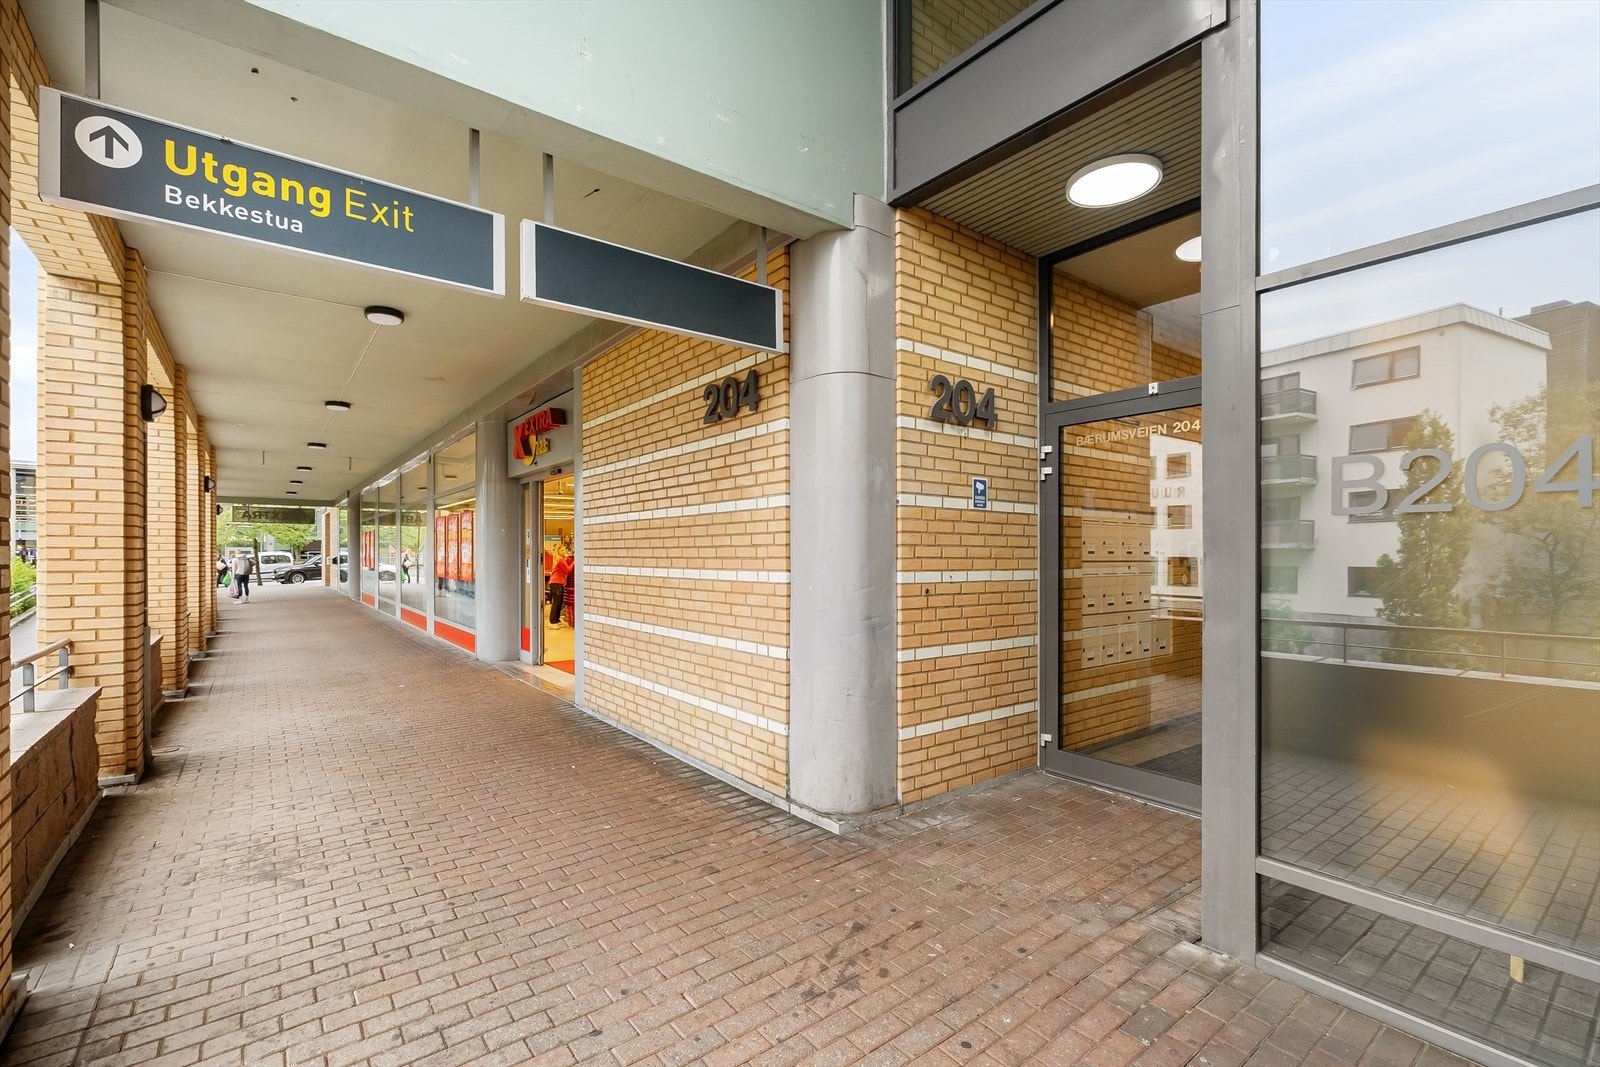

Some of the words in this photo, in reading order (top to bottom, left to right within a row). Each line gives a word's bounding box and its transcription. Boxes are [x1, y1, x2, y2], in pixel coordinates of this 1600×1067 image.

[164, 139, 331, 219] Utgang
[345, 189, 414, 233] Exit
[164, 184, 304, 234] Bekkestua
[524, 408, 552, 435] EXTRA
[703, 369, 760, 425] 204
[929, 373, 998, 428] 204
[1075, 423, 1167, 447] BÆRUMSVEIEN
[1172, 419, 1201, 434] 204
[1330, 434, 1600, 516] B204
